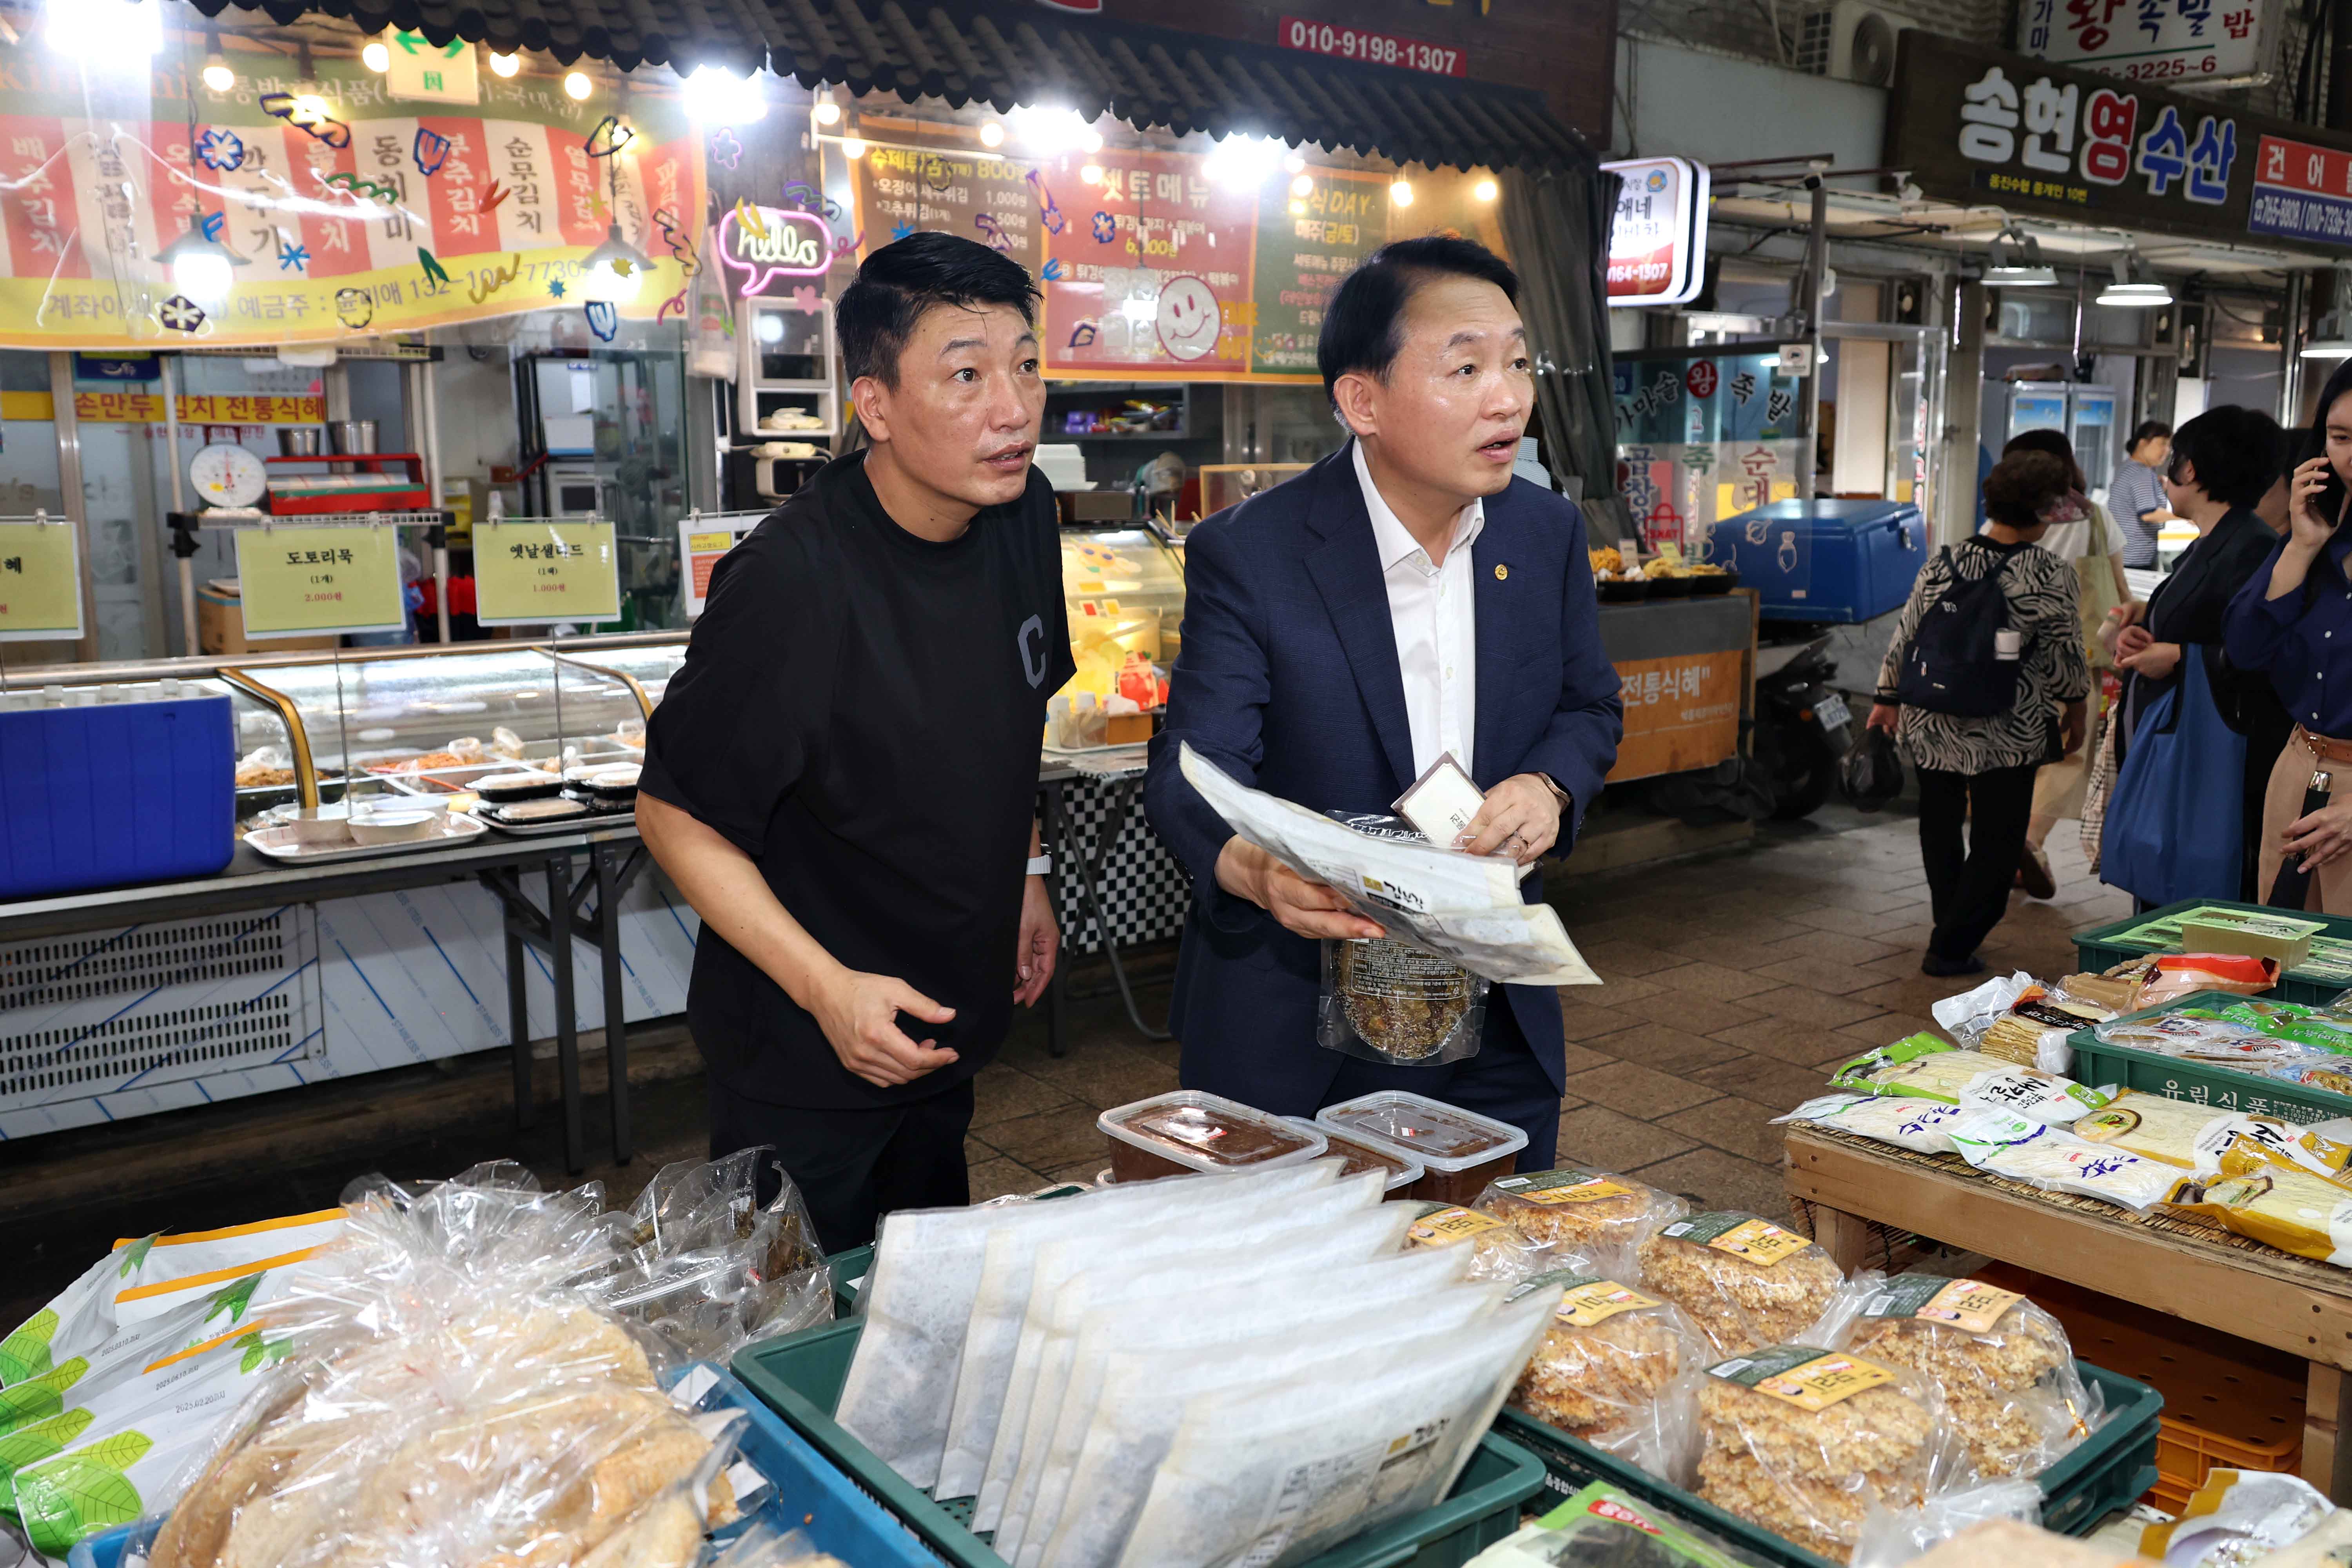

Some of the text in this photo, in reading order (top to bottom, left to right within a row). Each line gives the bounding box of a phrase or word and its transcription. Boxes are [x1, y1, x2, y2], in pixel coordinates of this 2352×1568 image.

[1290, 20, 1457, 74] 010-9198-1307
[1959, 67, 2236, 205] 송현영수산
[438, 133, 479, 236] 부추김치
[505, 136, 542, 234] 순무김치
[738, 220, 819, 267] hello
[238, 292, 310, 318] 예금주
[74, 394, 154, 419] 손만두
[225, 396, 327, 420] 전통식혜
[1741, 447, 1777, 506] 순대
[285, 549, 354, 565] 도토리묵
[510, 543, 584, 559] 옛날샐러드
[1018, 614, 1046, 689] C
[2160, 1080, 2271, 1117] 유림식품
